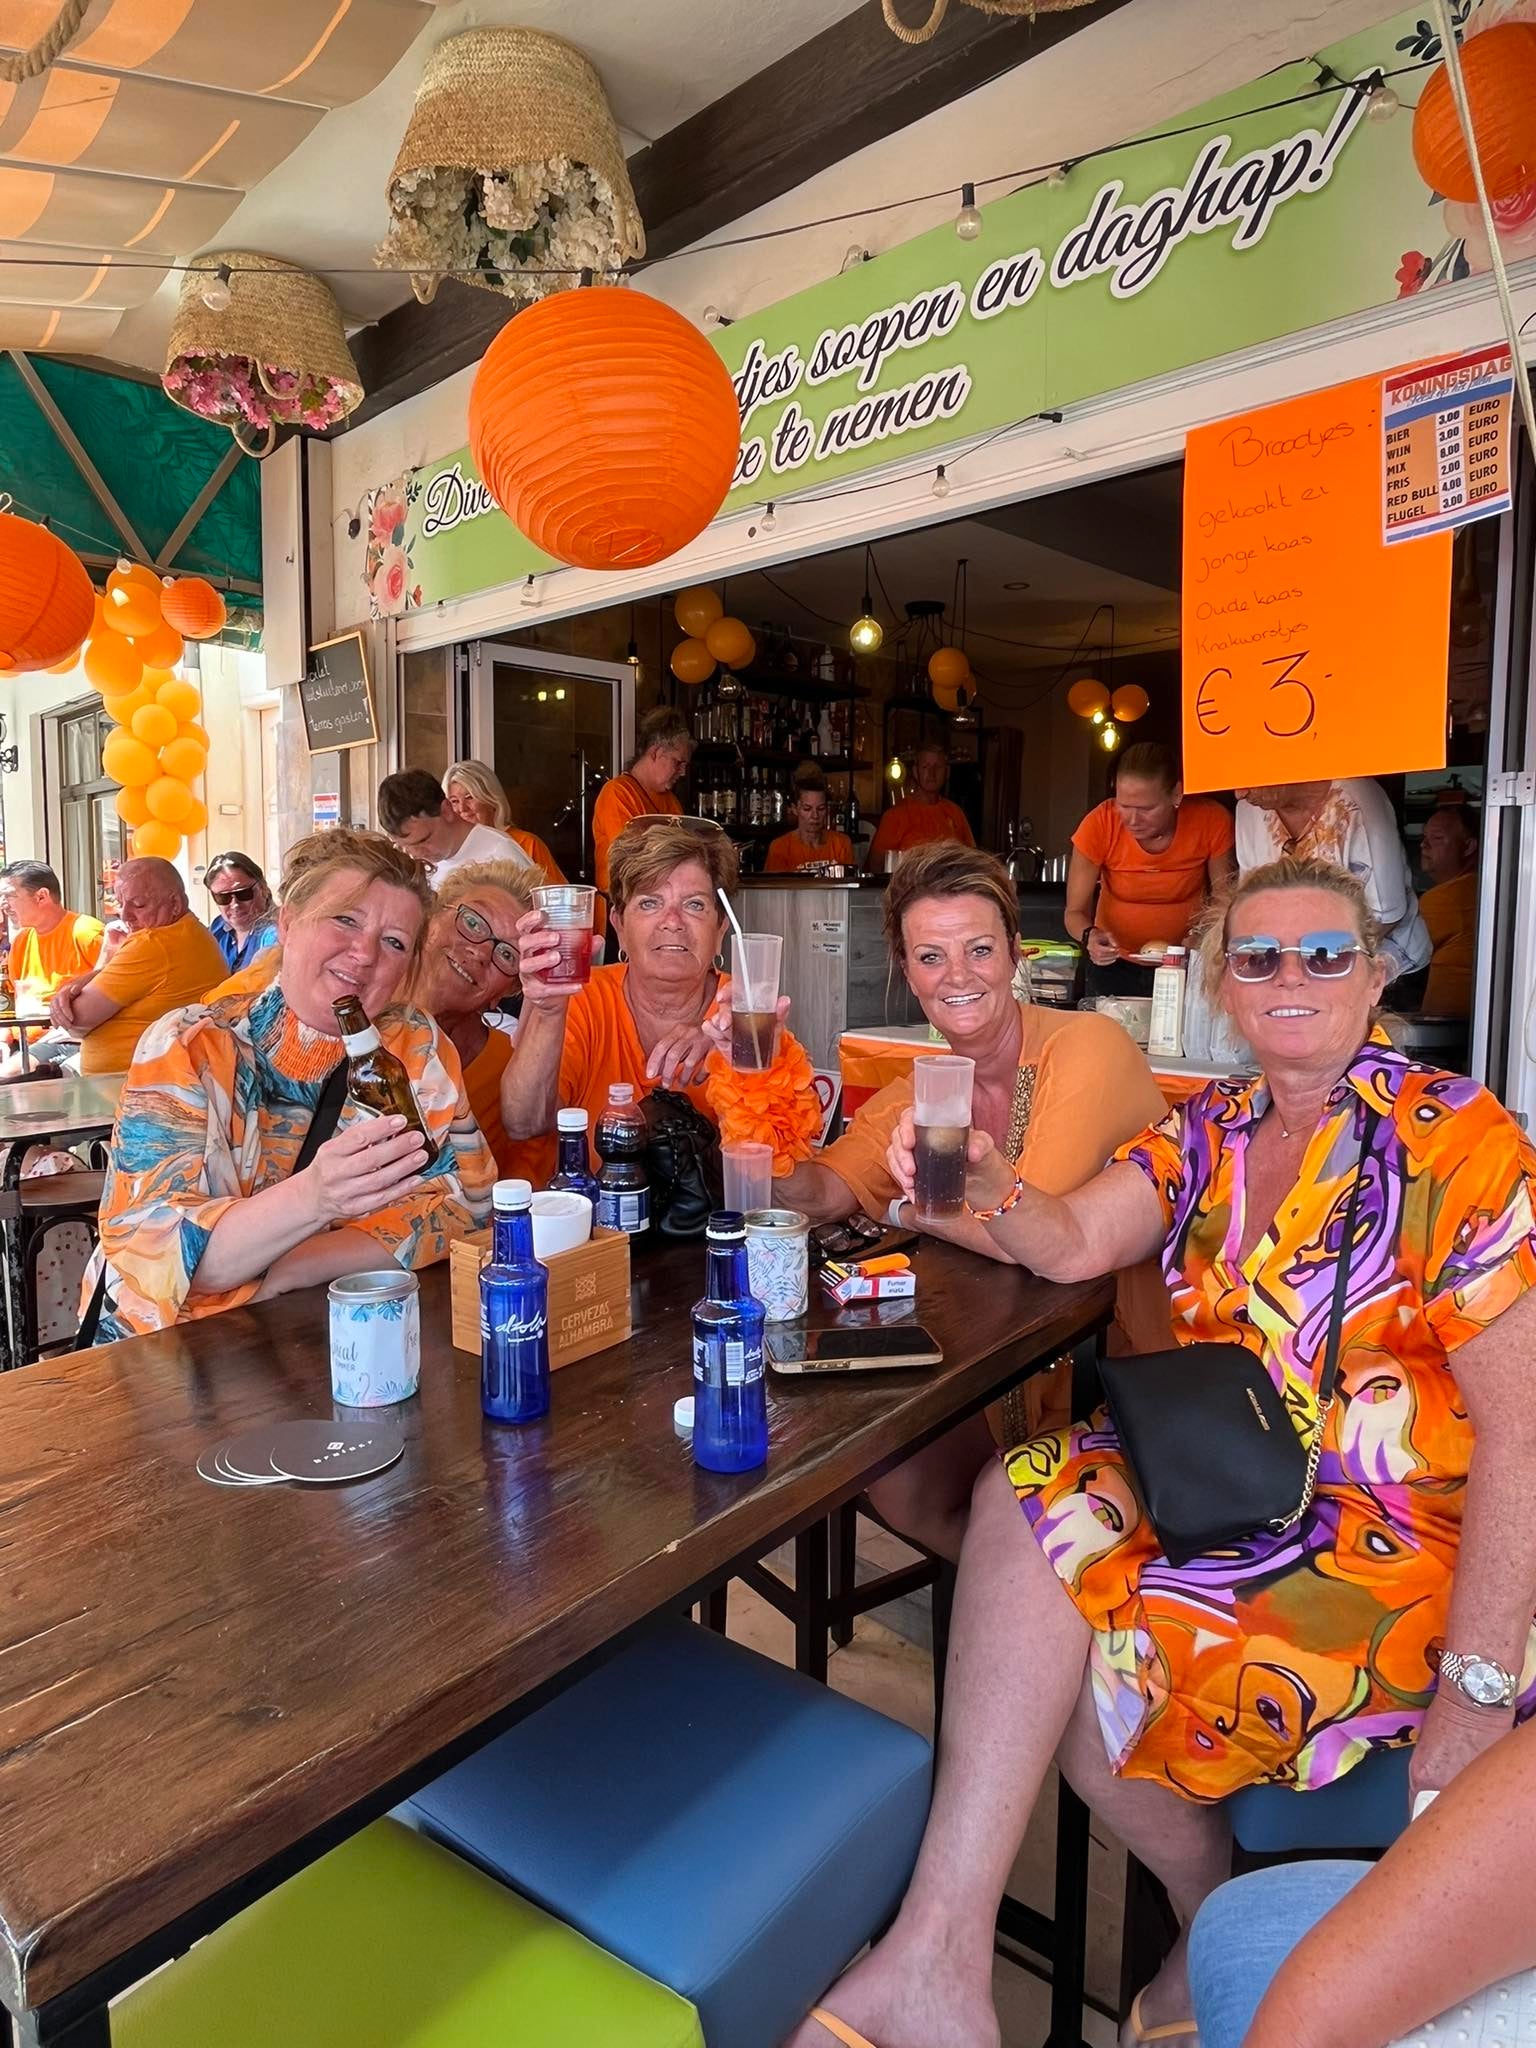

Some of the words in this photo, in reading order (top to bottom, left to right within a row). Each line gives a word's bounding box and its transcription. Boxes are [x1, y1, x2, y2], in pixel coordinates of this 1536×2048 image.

[423, 464, 495, 535] Dive
[733, 344, 800, 428] djes
[809, 287, 960, 386] soepen
[975, 254, 1040, 314] en
[1055, 68, 1383, 292] daghap!
[1391, 356, 1512, 406] KONINGSDAG
[775, 407, 812, 467] te
[819, 370, 966, 455] nemen
[1386, 428, 1410, 445] BIER
[1438, 410, 1460, 426] 3.00
[1469, 399, 1500, 416] EURO
[1386, 444, 1411, 461] WIJN
[1438, 426, 1460, 442] 3.00
[1468, 414, 1499, 432] EURO
[1386, 461, 1406, 477] MIX
[1468, 430, 1498, 448] EURO
[1387, 476, 1410, 492] FRIS
[1441, 460, 1460, 476] 2.00
[1469, 446, 1498, 465] EURO
[1387, 492, 1408, 508] RED
[1412, 485, 1439, 501] BULL
[1441, 477, 1462, 492] 4.00
[1469, 463, 1498, 482] EURO
[1387, 507, 1426, 524] FLUGEL
[1442, 493, 1463, 509] 3.00
[1469, 481, 1498, 500] EURO
[1199, 484, 1292, 538] gekookt
[1264, 536, 1312, 551] kaas
[1196, 599, 1249, 620] Oude
[1253, 587, 1303, 605] kaas
[1196, 667, 1232, 735] €
[559, 1316, 614, 1349] ALHAMBRA
[561, 1300, 610, 1332] CERVEZAS
